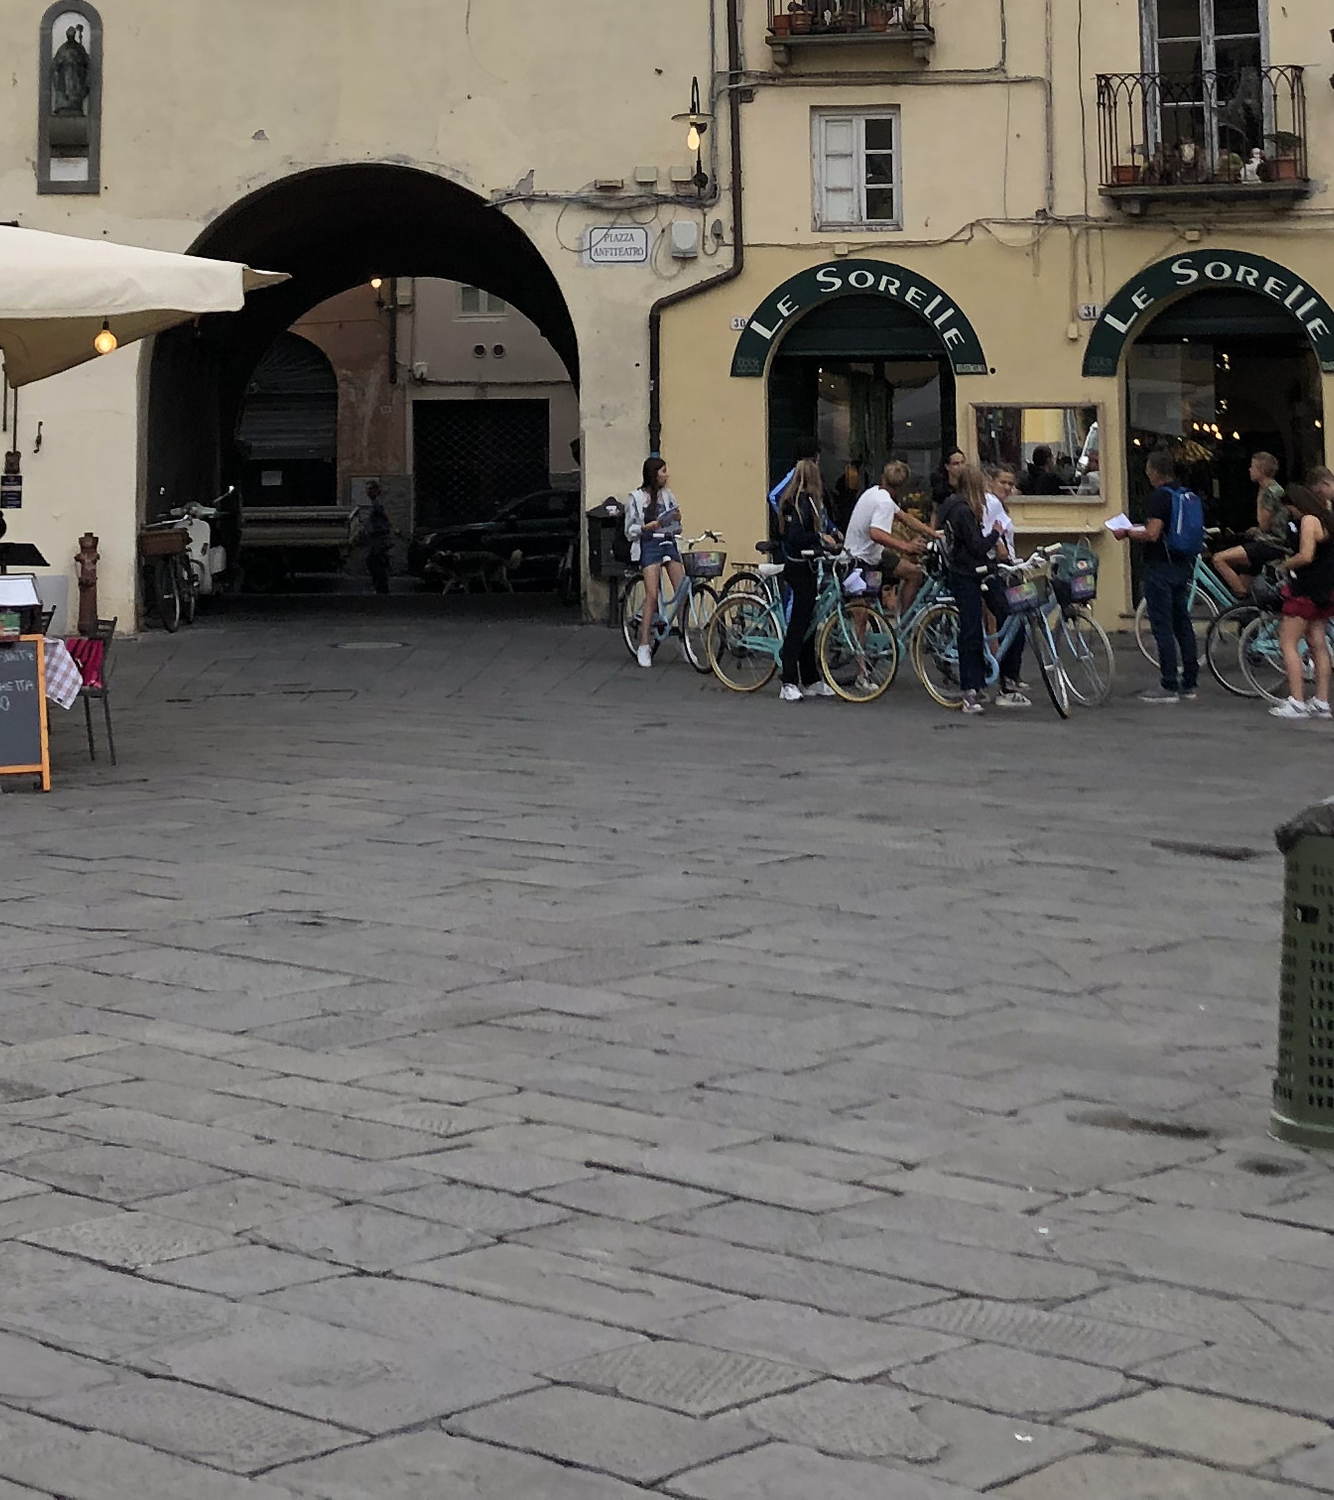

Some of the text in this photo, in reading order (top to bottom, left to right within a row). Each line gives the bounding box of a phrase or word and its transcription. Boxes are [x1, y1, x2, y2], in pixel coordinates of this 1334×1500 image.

[603, 233, 635, 243] PIAZZA
[592, 246, 644, 257] ANFITEATRO
[1170, 258, 1331, 342] SORELLE
[815, 267, 966, 351] SORELLE
[1083, 305, 1097, 318] 31
[733, 318, 747, 328] 30
